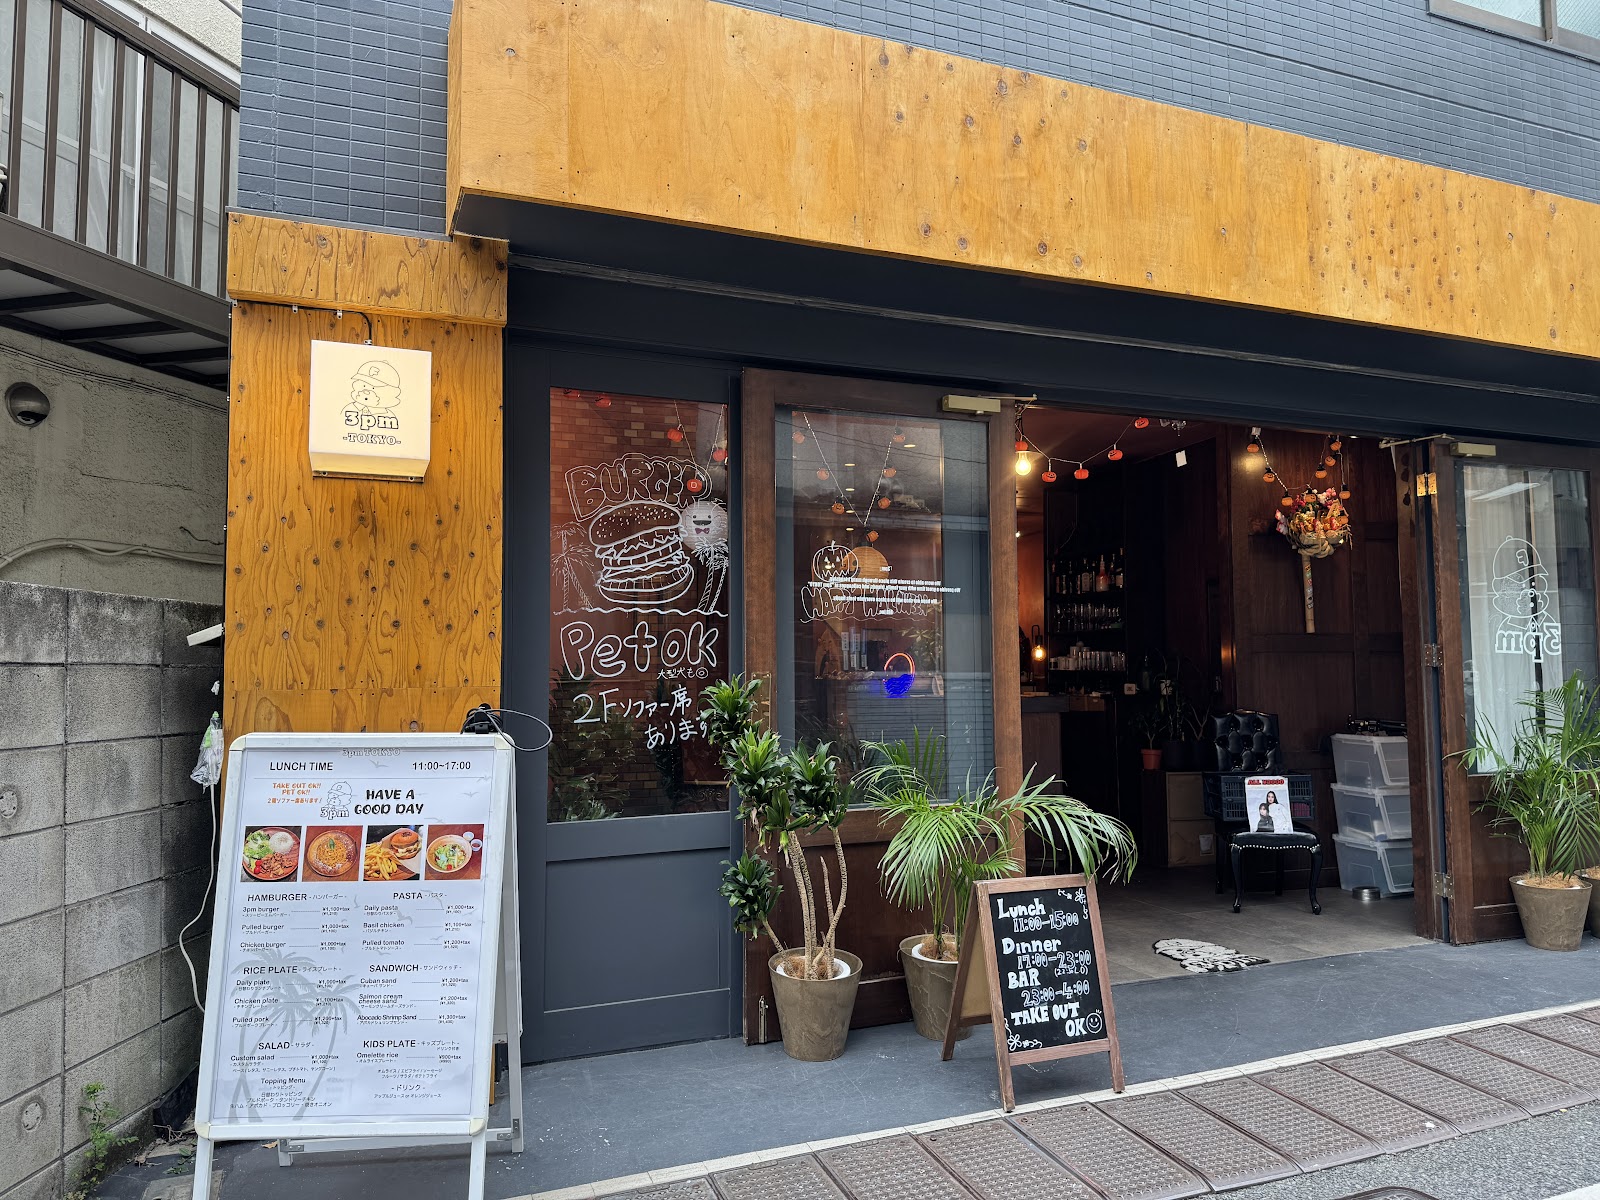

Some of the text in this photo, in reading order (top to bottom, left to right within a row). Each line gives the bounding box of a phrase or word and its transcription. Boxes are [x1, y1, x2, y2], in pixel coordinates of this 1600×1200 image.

[345, 411, 399, 430] 3pm
[270, 762, 333, 771] LUNCH TIME
[366, 790, 415, 800] HAVE A
[320, 807, 349, 820] 3pm
[354, 804, 424, 814] GOOD DAY
[247, 894, 307, 902] HAMBURGER
[997, 898, 1046, 919] Lunch
[1002, 938, 1061, 954] Dinner
[1008, 968, 1041, 989] BAR
[1011, 1002, 1080, 1026] TAKE OUT
[1065, 1018, 1087, 1037] OK
[259, 1042, 290, 1050] SALAD
[363, 1040, 384, 1048] KIDS
[387, 1040, 416, 1048] PLATE
